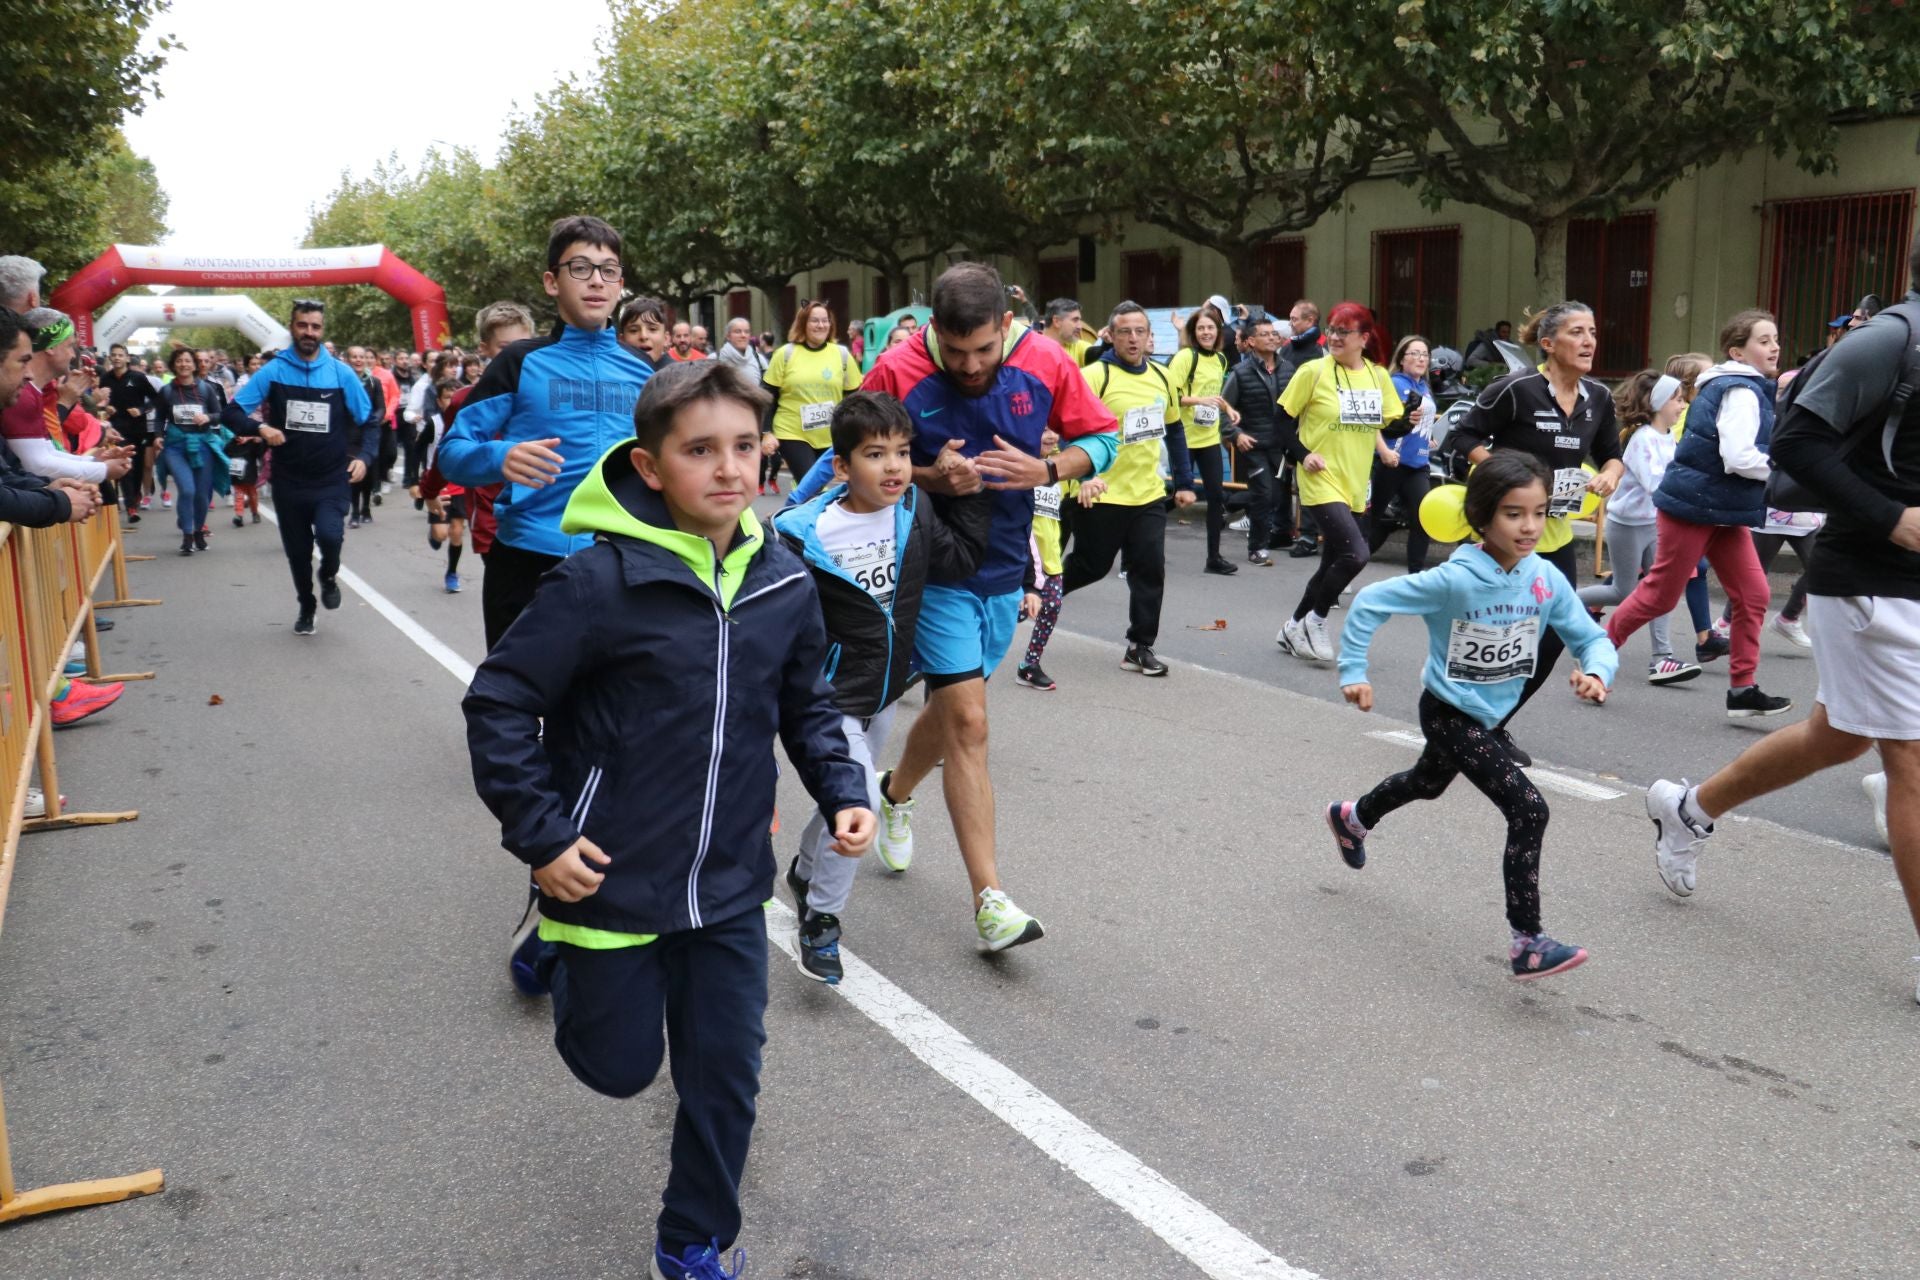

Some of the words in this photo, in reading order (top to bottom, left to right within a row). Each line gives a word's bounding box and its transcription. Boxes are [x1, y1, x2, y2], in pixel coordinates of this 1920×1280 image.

[183, 257, 276, 268] AYUNTAMIENTO
[279, 257, 295, 268] DE
[255, 272, 266, 280] DE
[269, 271, 311, 280] DEPORTES
[300, 411, 315, 422] 76
[810, 410, 827, 421] 250
[1135, 417, 1149, 429] 49
[1034, 490, 1059, 506] 3465
[1465, 604, 1540, 620] TEAMWORK
[1463, 637, 1522, 663] 2665
